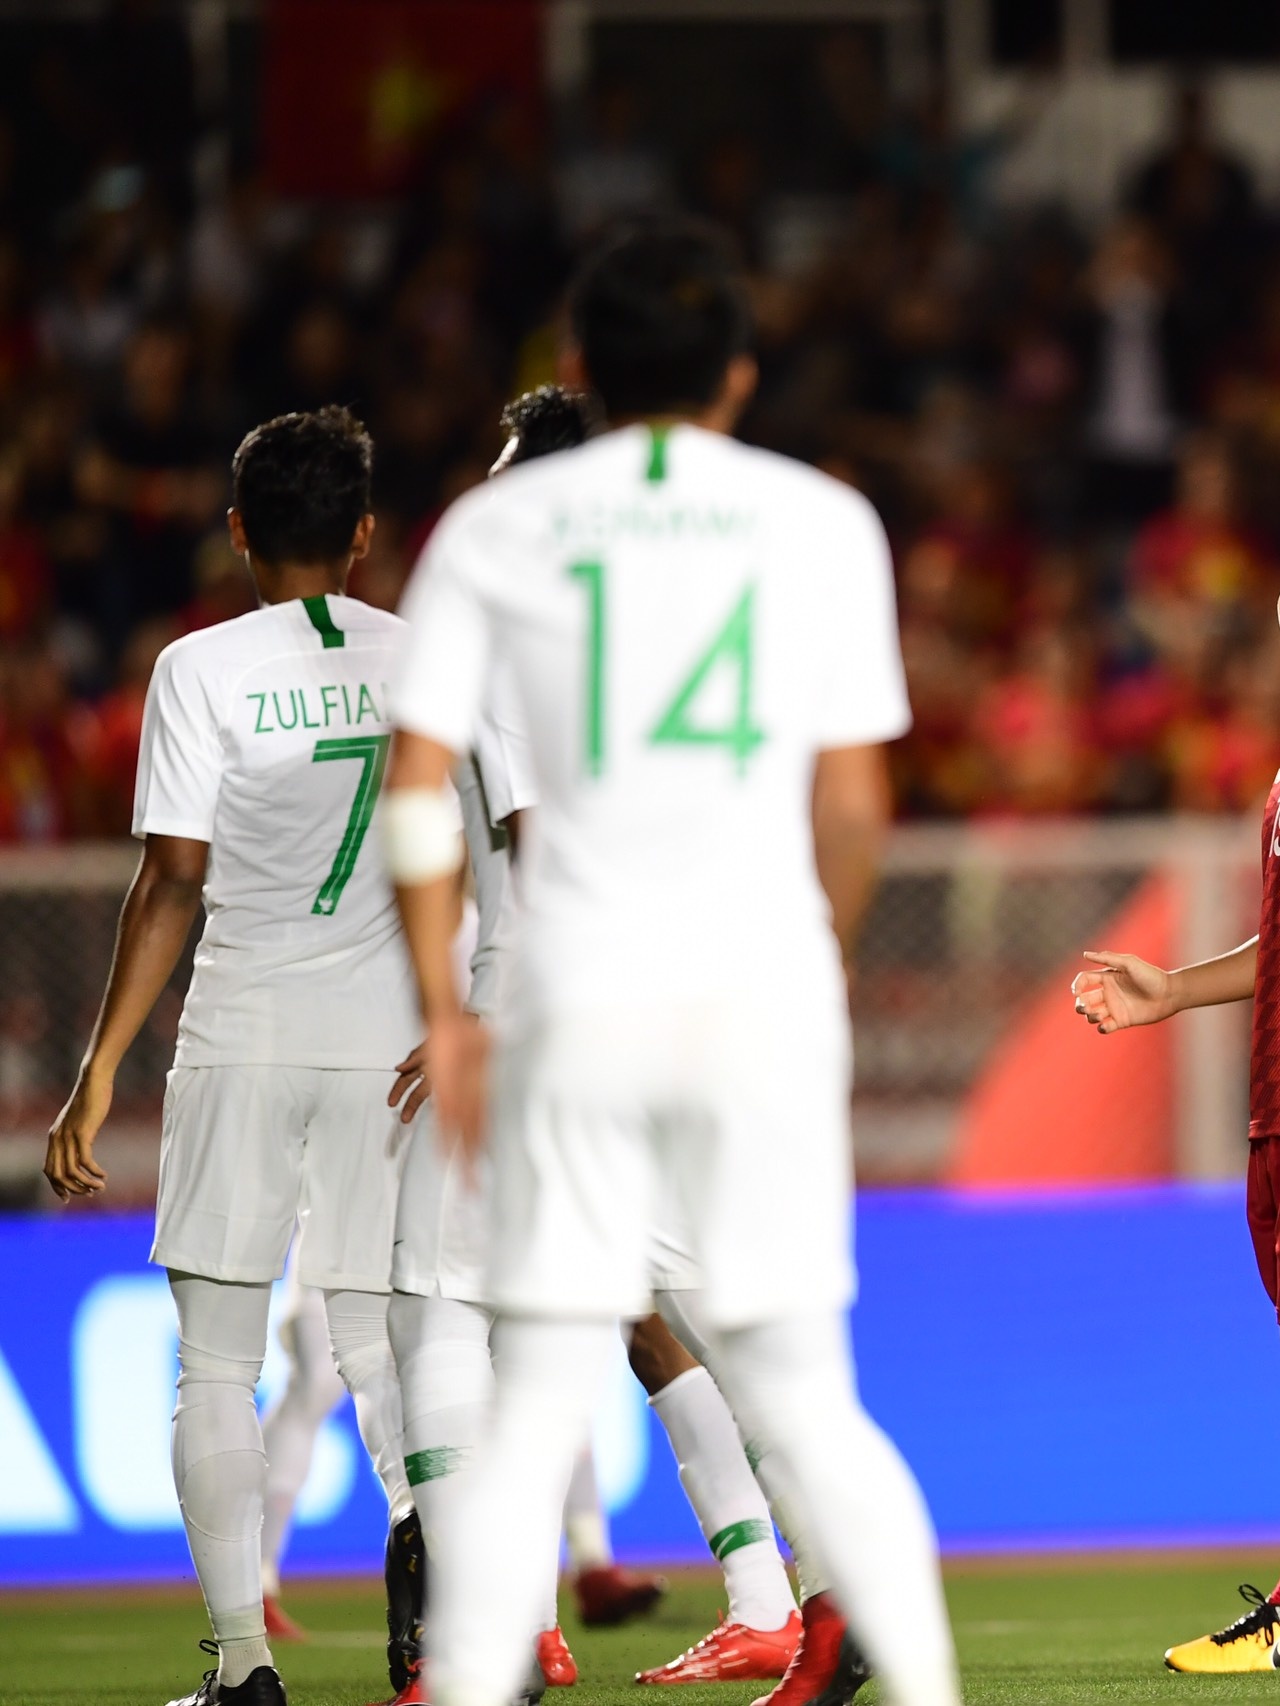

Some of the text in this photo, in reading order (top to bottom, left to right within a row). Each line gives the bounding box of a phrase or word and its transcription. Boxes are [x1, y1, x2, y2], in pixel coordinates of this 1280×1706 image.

[246, 682, 393, 735] ZULFIA
[563, 560, 769, 780] 14
[310, 734, 392, 916] 7
